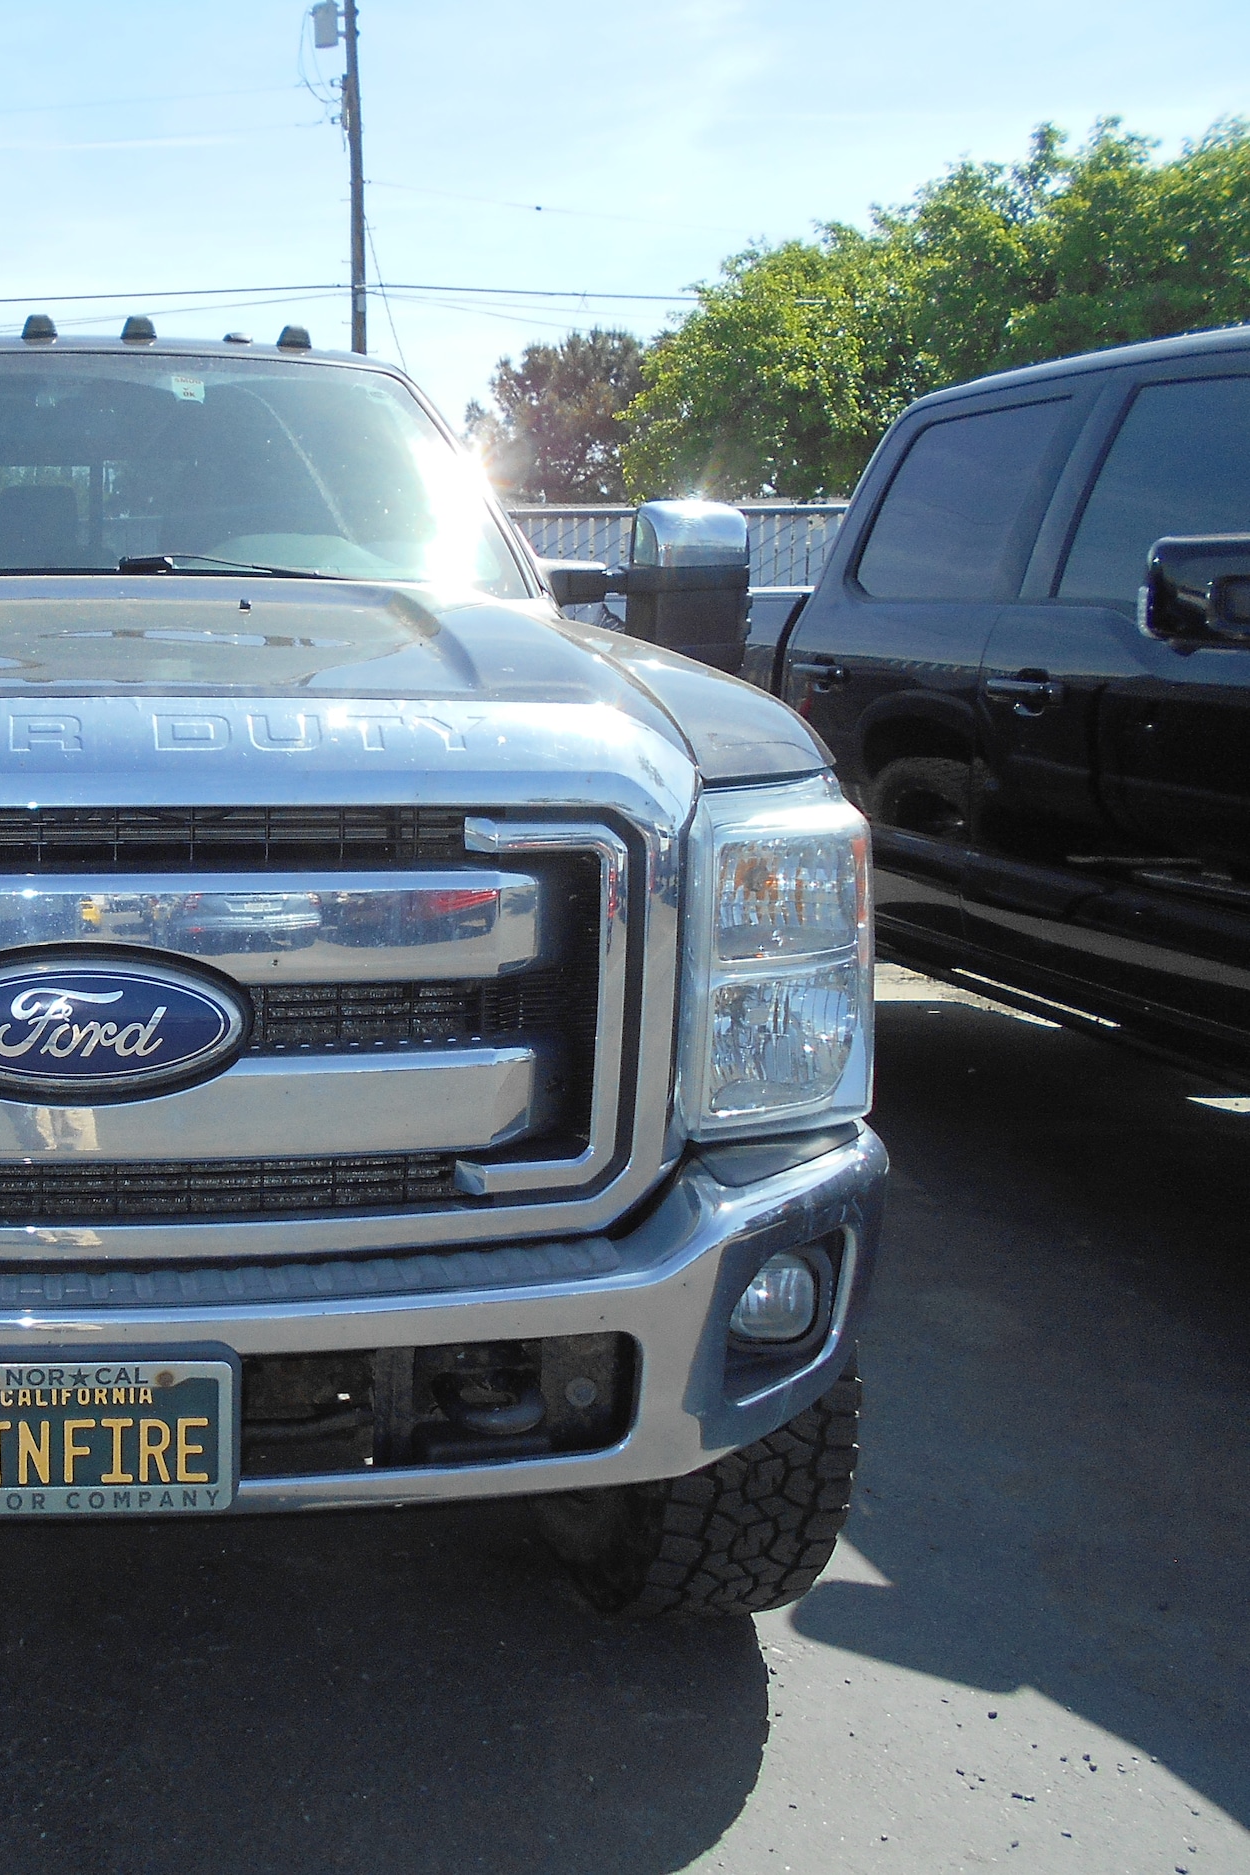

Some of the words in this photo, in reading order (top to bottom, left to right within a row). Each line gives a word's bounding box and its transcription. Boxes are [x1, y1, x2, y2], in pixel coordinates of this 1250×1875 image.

[152, 713, 488, 752] DUTY
[5, 1368, 65, 1387] NOR
[94, 1366, 149, 1386] CAL
[0, 1387, 153, 1407] CALIFORNIA
[65, 1488, 221, 1510] COMPANY
